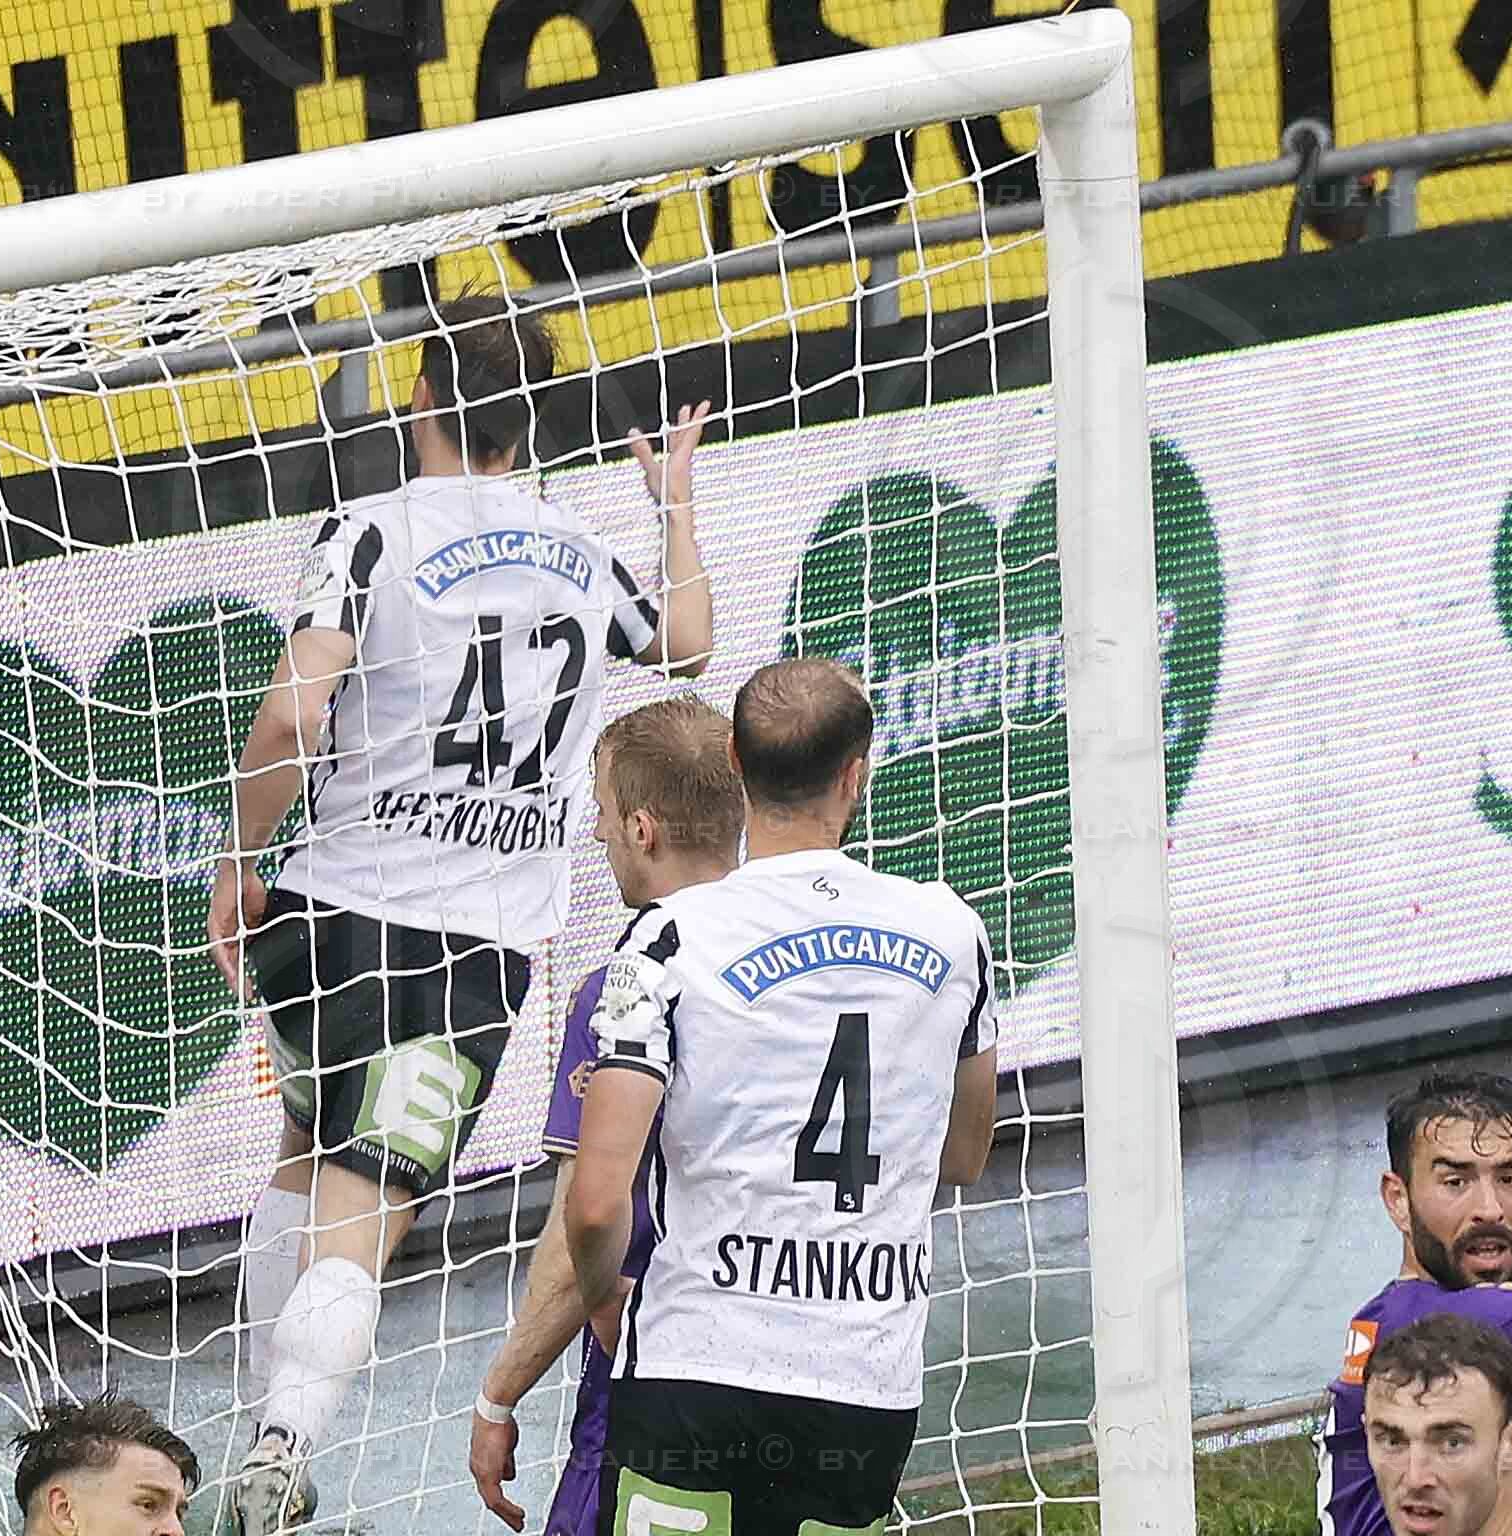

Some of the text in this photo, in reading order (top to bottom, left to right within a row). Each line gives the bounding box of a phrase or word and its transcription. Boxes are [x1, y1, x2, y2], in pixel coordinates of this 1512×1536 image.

[422, 531, 592, 595] PUNTIGAMER
[432, 613, 587, 796] 42
[735, 927, 944, 994] PUNTIGAMER
[793, 1012, 881, 1213] 4
